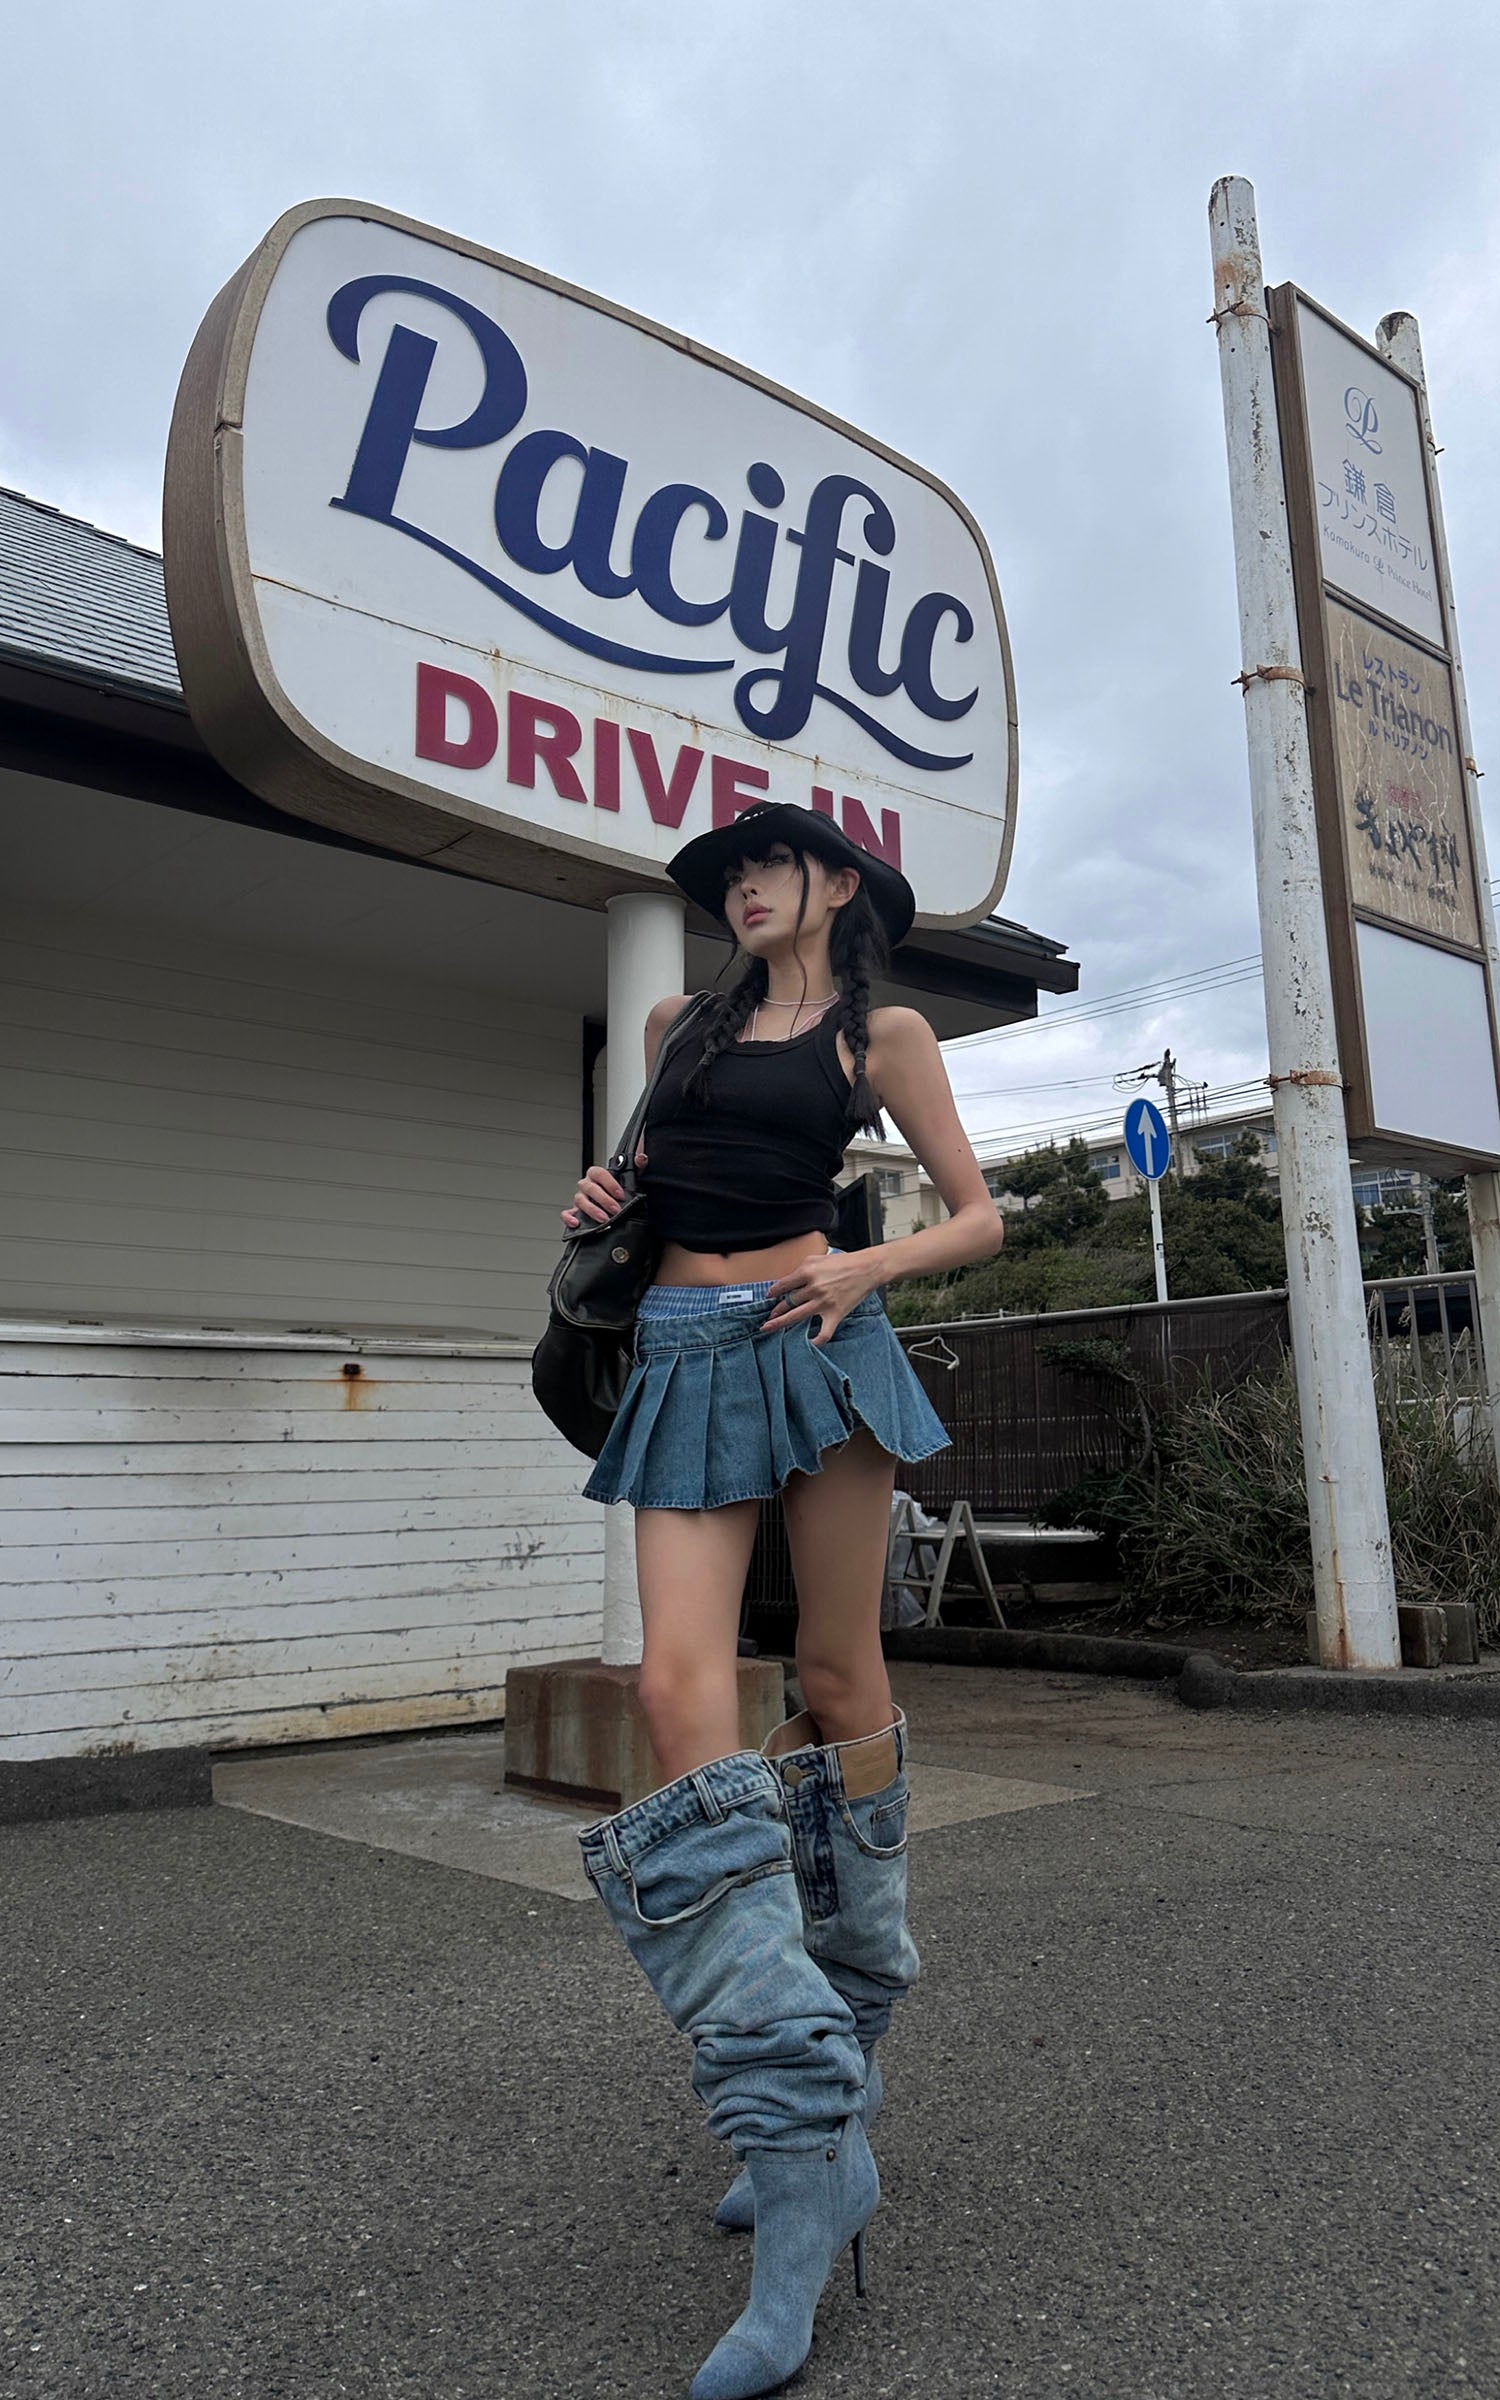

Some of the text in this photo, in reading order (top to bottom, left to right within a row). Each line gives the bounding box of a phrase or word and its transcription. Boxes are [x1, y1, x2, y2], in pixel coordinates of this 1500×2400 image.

[327, 275, 979, 771] Pacific
[1341, 458, 1397, 524] 鎌倉
[1323, 523, 1370, 564] Kamakura
[1335, 661, 1453, 755] Le Trianon
[1362, 649, 1420, 695] レストラン
[415, 662, 769, 830] DRIVE
